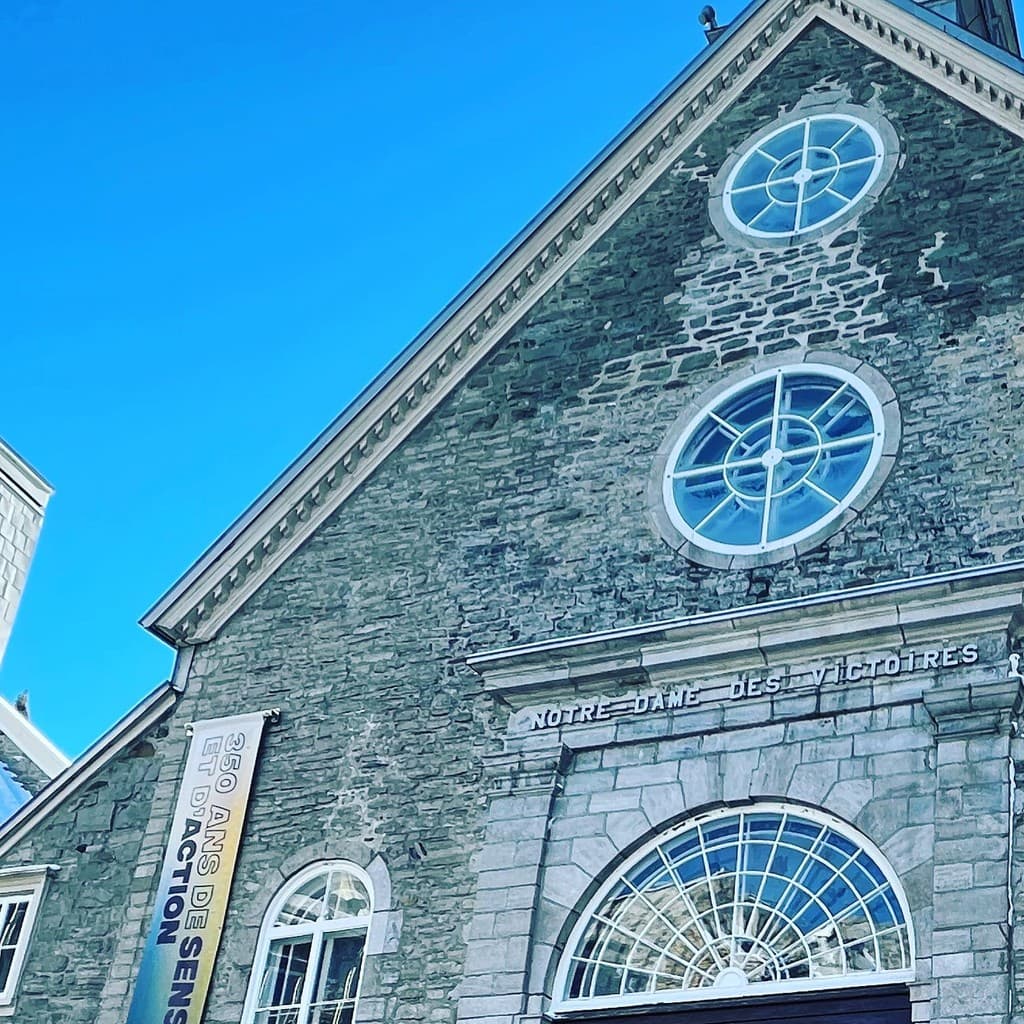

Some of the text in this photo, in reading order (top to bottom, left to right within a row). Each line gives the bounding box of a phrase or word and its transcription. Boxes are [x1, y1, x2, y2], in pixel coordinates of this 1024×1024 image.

[531, 643, 979, 730] NOTRE DAME DES VICTOIRES
[215, 732, 245, 794] 350
[156, 735, 224, 945] ET D'ACTION
[196, 804, 231, 876] ANS
[184, 884, 214, 930] DE
